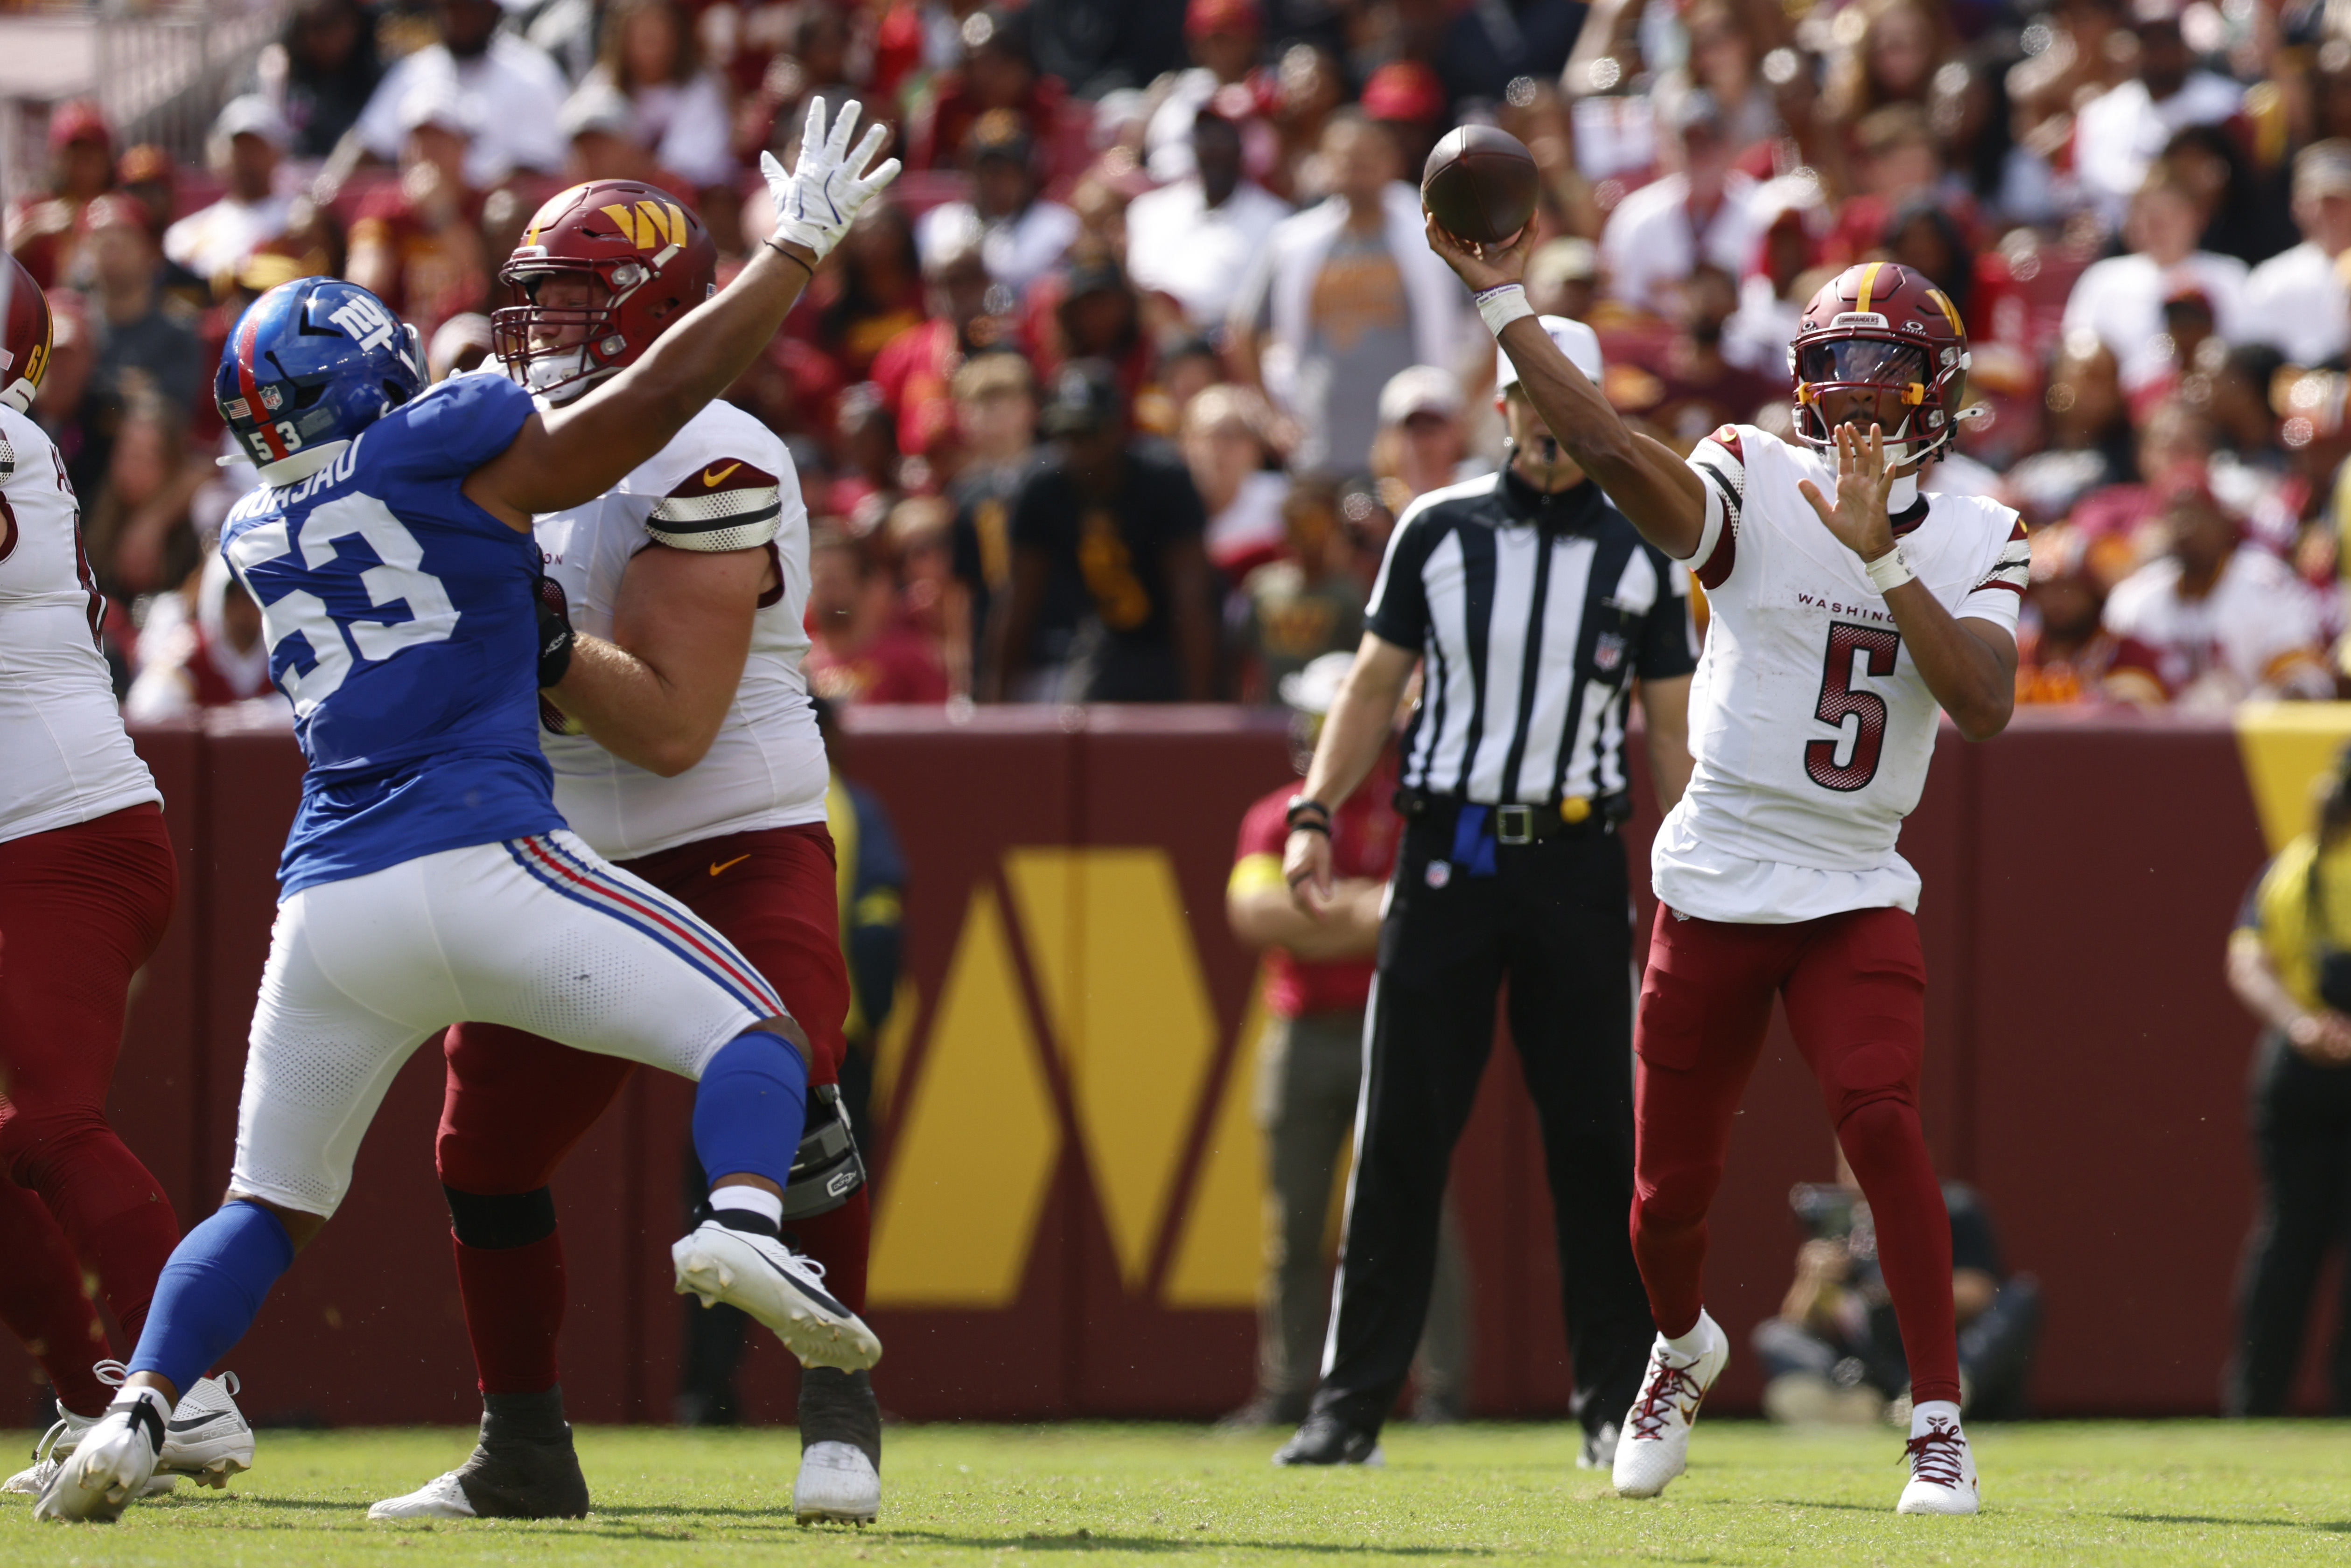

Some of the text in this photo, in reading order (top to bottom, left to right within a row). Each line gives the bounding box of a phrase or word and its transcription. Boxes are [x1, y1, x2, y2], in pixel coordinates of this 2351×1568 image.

[248, 420, 302, 460] 53
[227, 490, 461, 718] 53
[1804, 620, 1901, 792] 5
[202, 1424, 240, 1440] FORCE
